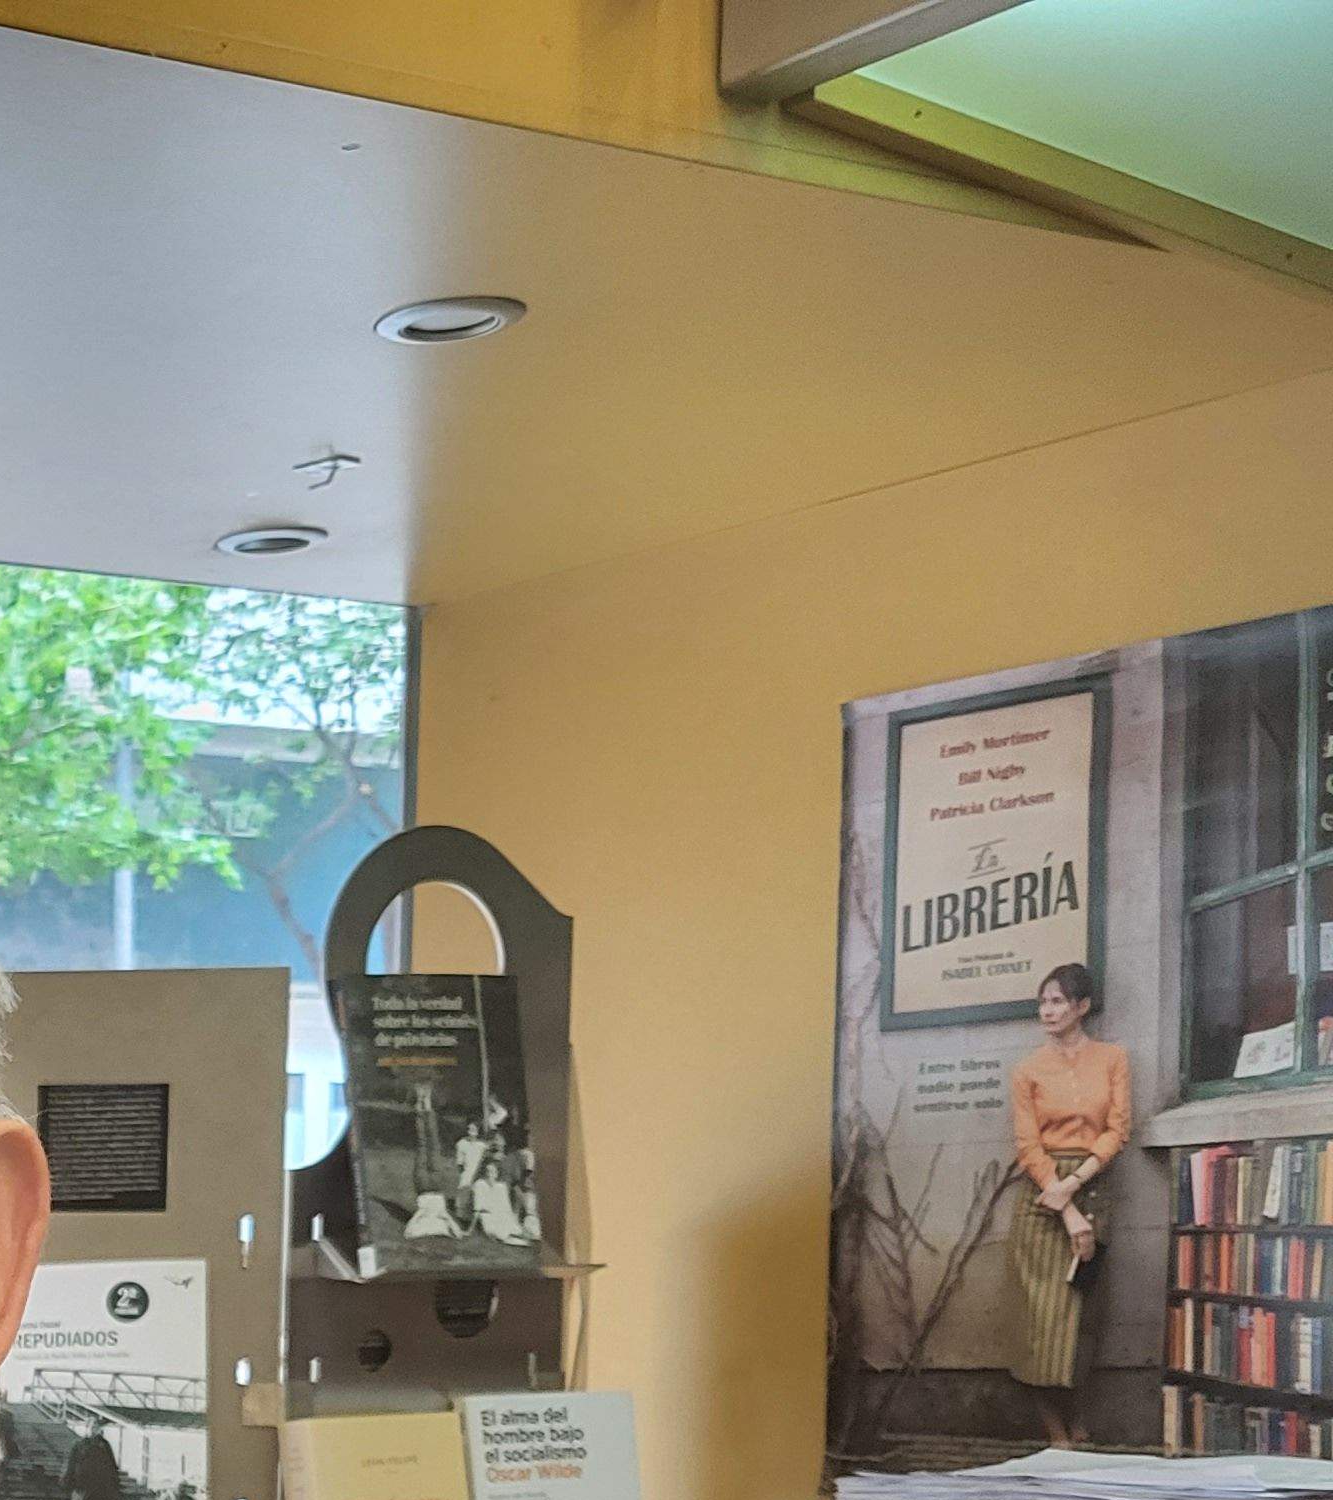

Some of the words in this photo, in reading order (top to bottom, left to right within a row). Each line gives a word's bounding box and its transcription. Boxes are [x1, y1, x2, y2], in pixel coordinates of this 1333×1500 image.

[930, 801, 984, 821] Patricia
[901, 851, 1079, 954] LIBRERÍA
[481, 1410, 496, 1427] El
[501, 1409, 539, 1425] alma
[483, 1428, 545, 1445] hombre
[550, 1426, 585, 1443] bajo
[485, 1448, 499, 1463] el
[502, 1446, 588, 1463] socialismo
[486, 1467, 532, 1483] Oscar
[535, 1464, 583, 1479] Wilde
